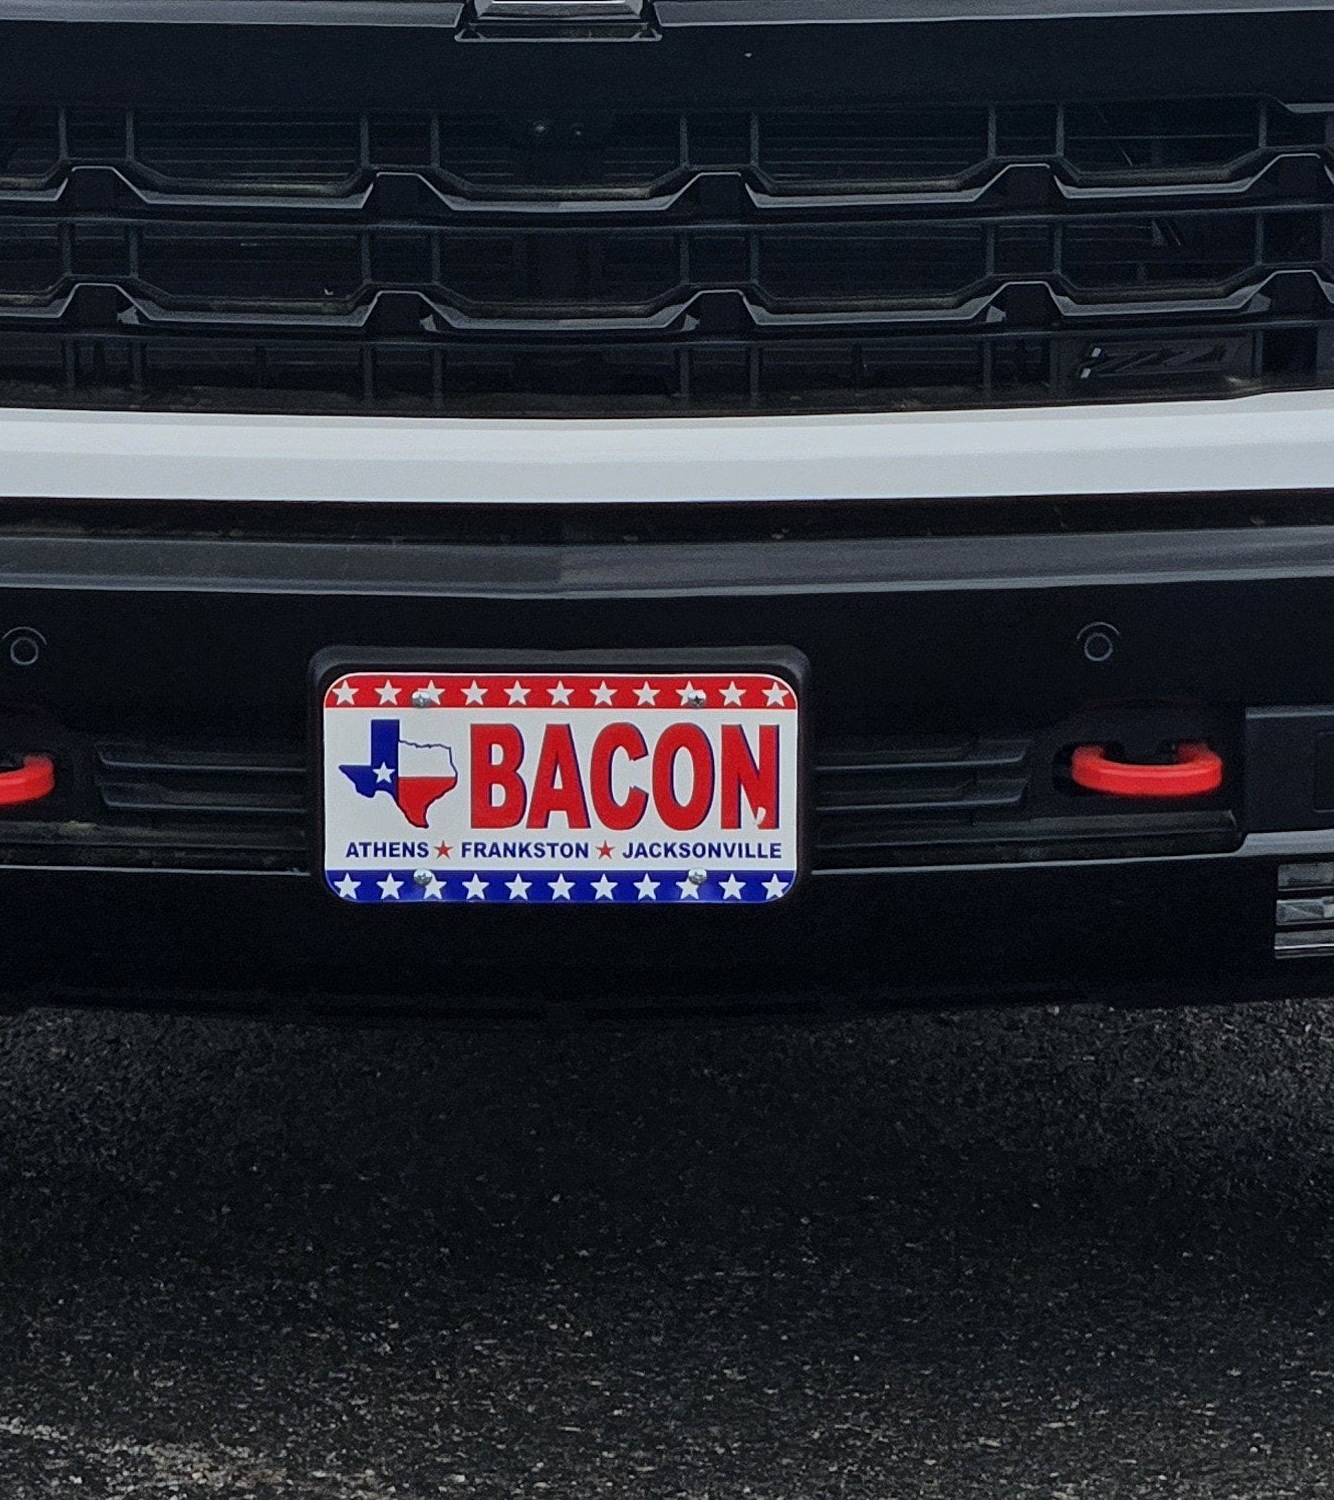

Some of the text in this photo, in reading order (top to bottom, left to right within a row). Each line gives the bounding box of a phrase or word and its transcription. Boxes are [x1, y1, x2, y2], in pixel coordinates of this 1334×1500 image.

[469, 722, 780, 830] BACON
[345, 841, 782, 859] ATHENS FRANKSTON JACKSONVILLE
